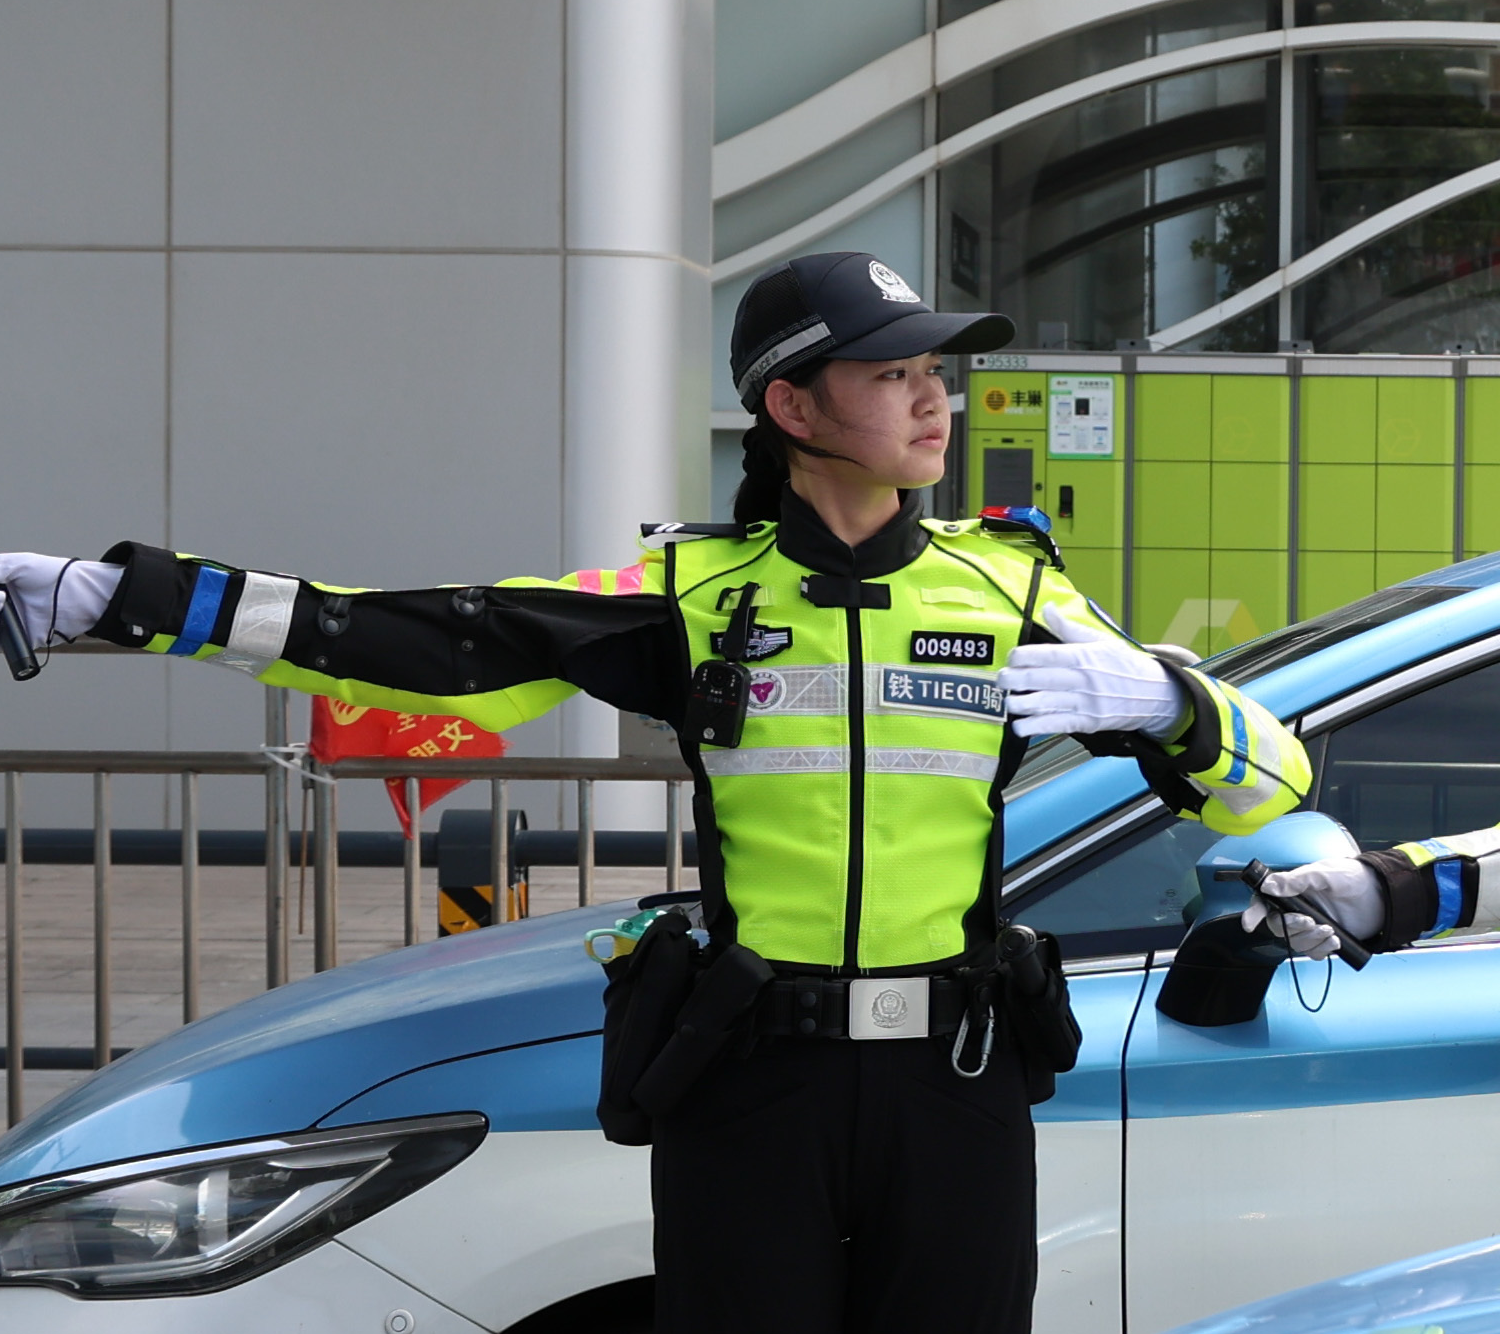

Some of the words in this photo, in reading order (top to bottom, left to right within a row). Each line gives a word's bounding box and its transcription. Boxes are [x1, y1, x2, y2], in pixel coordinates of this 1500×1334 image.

[987, 355, 1028, 368] 95333
[1011, 390, 1042, 406] 丰巢
[915, 638, 988, 658] 009493
[888, 672, 914, 700] 铁
[918, 679, 980, 705] TIEQI
[982, 684, 1004, 713] 骑
